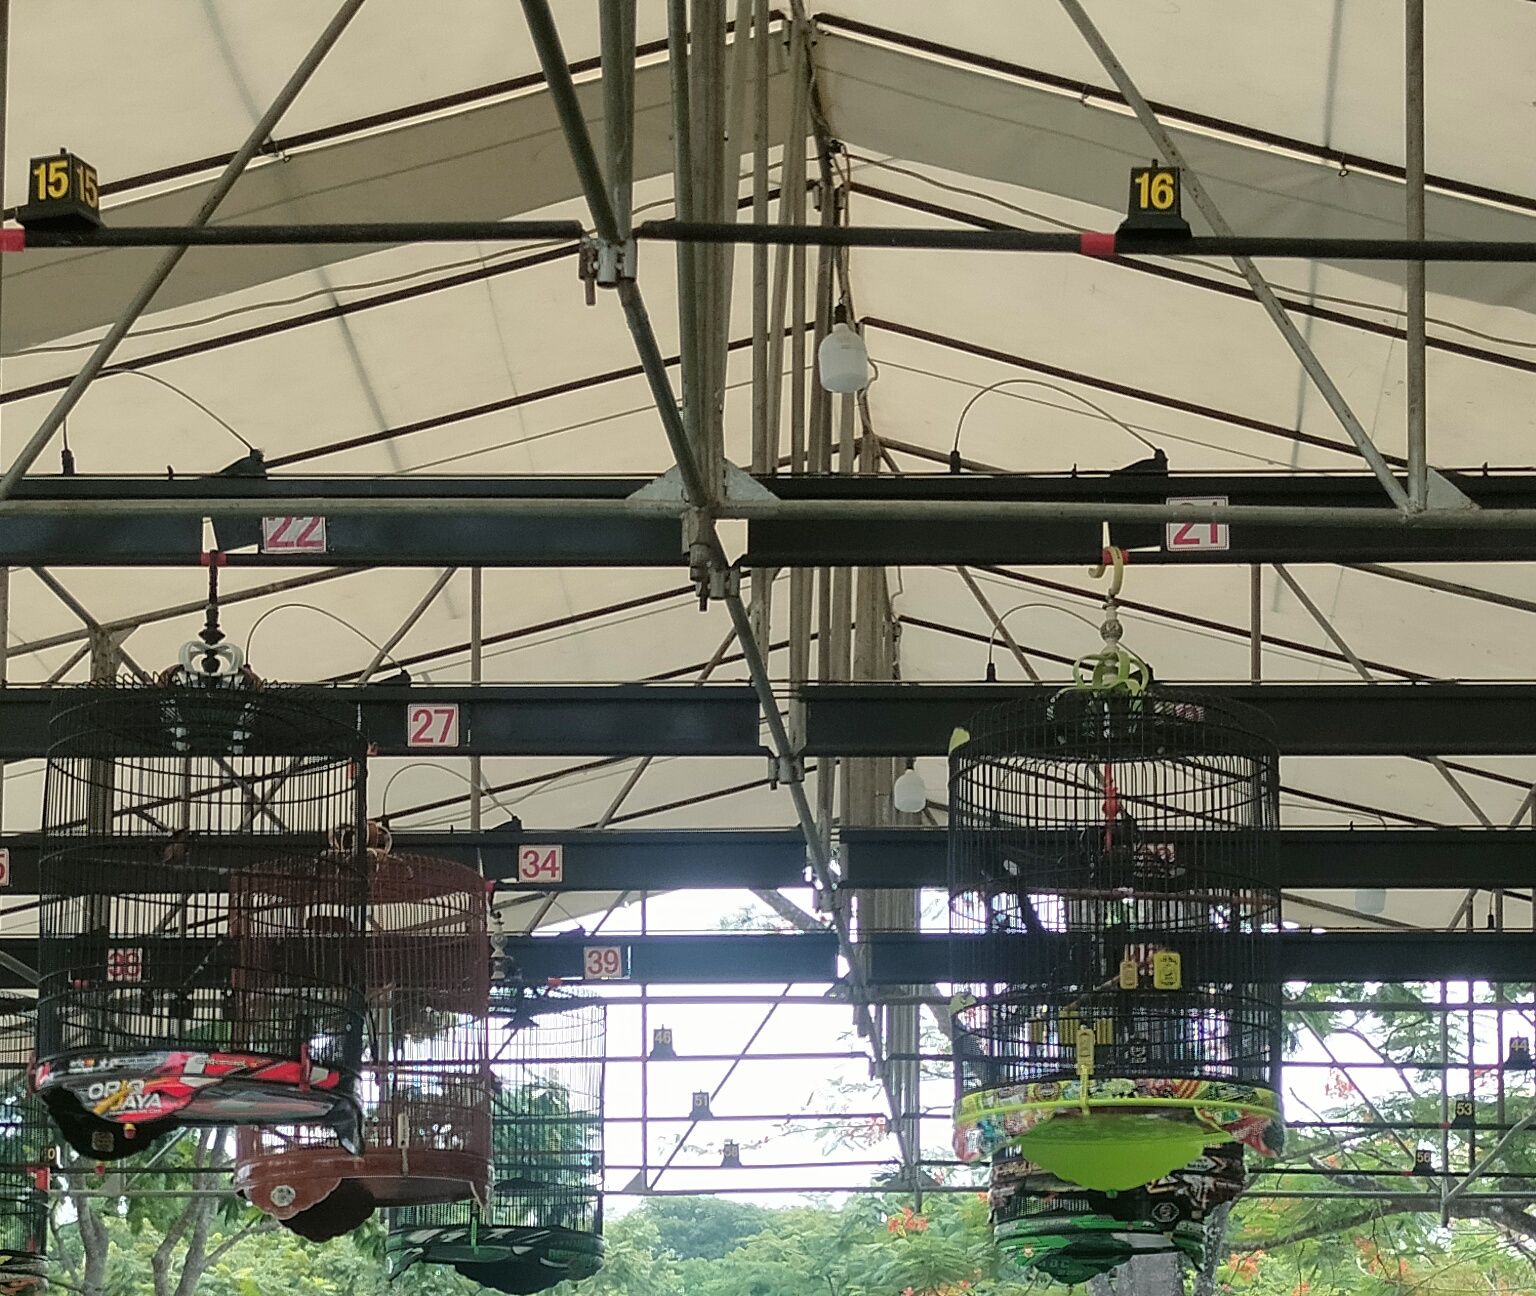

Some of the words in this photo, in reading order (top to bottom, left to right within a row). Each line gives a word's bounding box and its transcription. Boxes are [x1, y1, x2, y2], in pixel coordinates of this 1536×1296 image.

[33, 161, 69, 200] 15
[76, 166, 97, 208] 15
[1135, 173, 1174, 210] 16
[267, 517, 323, 549] 22
[411, 709, 455, 743] 27
[521, 850, 560, 879] 34
[587, 949, 619, 974] 39
[1456, 1103, 1472, 1116] 53
